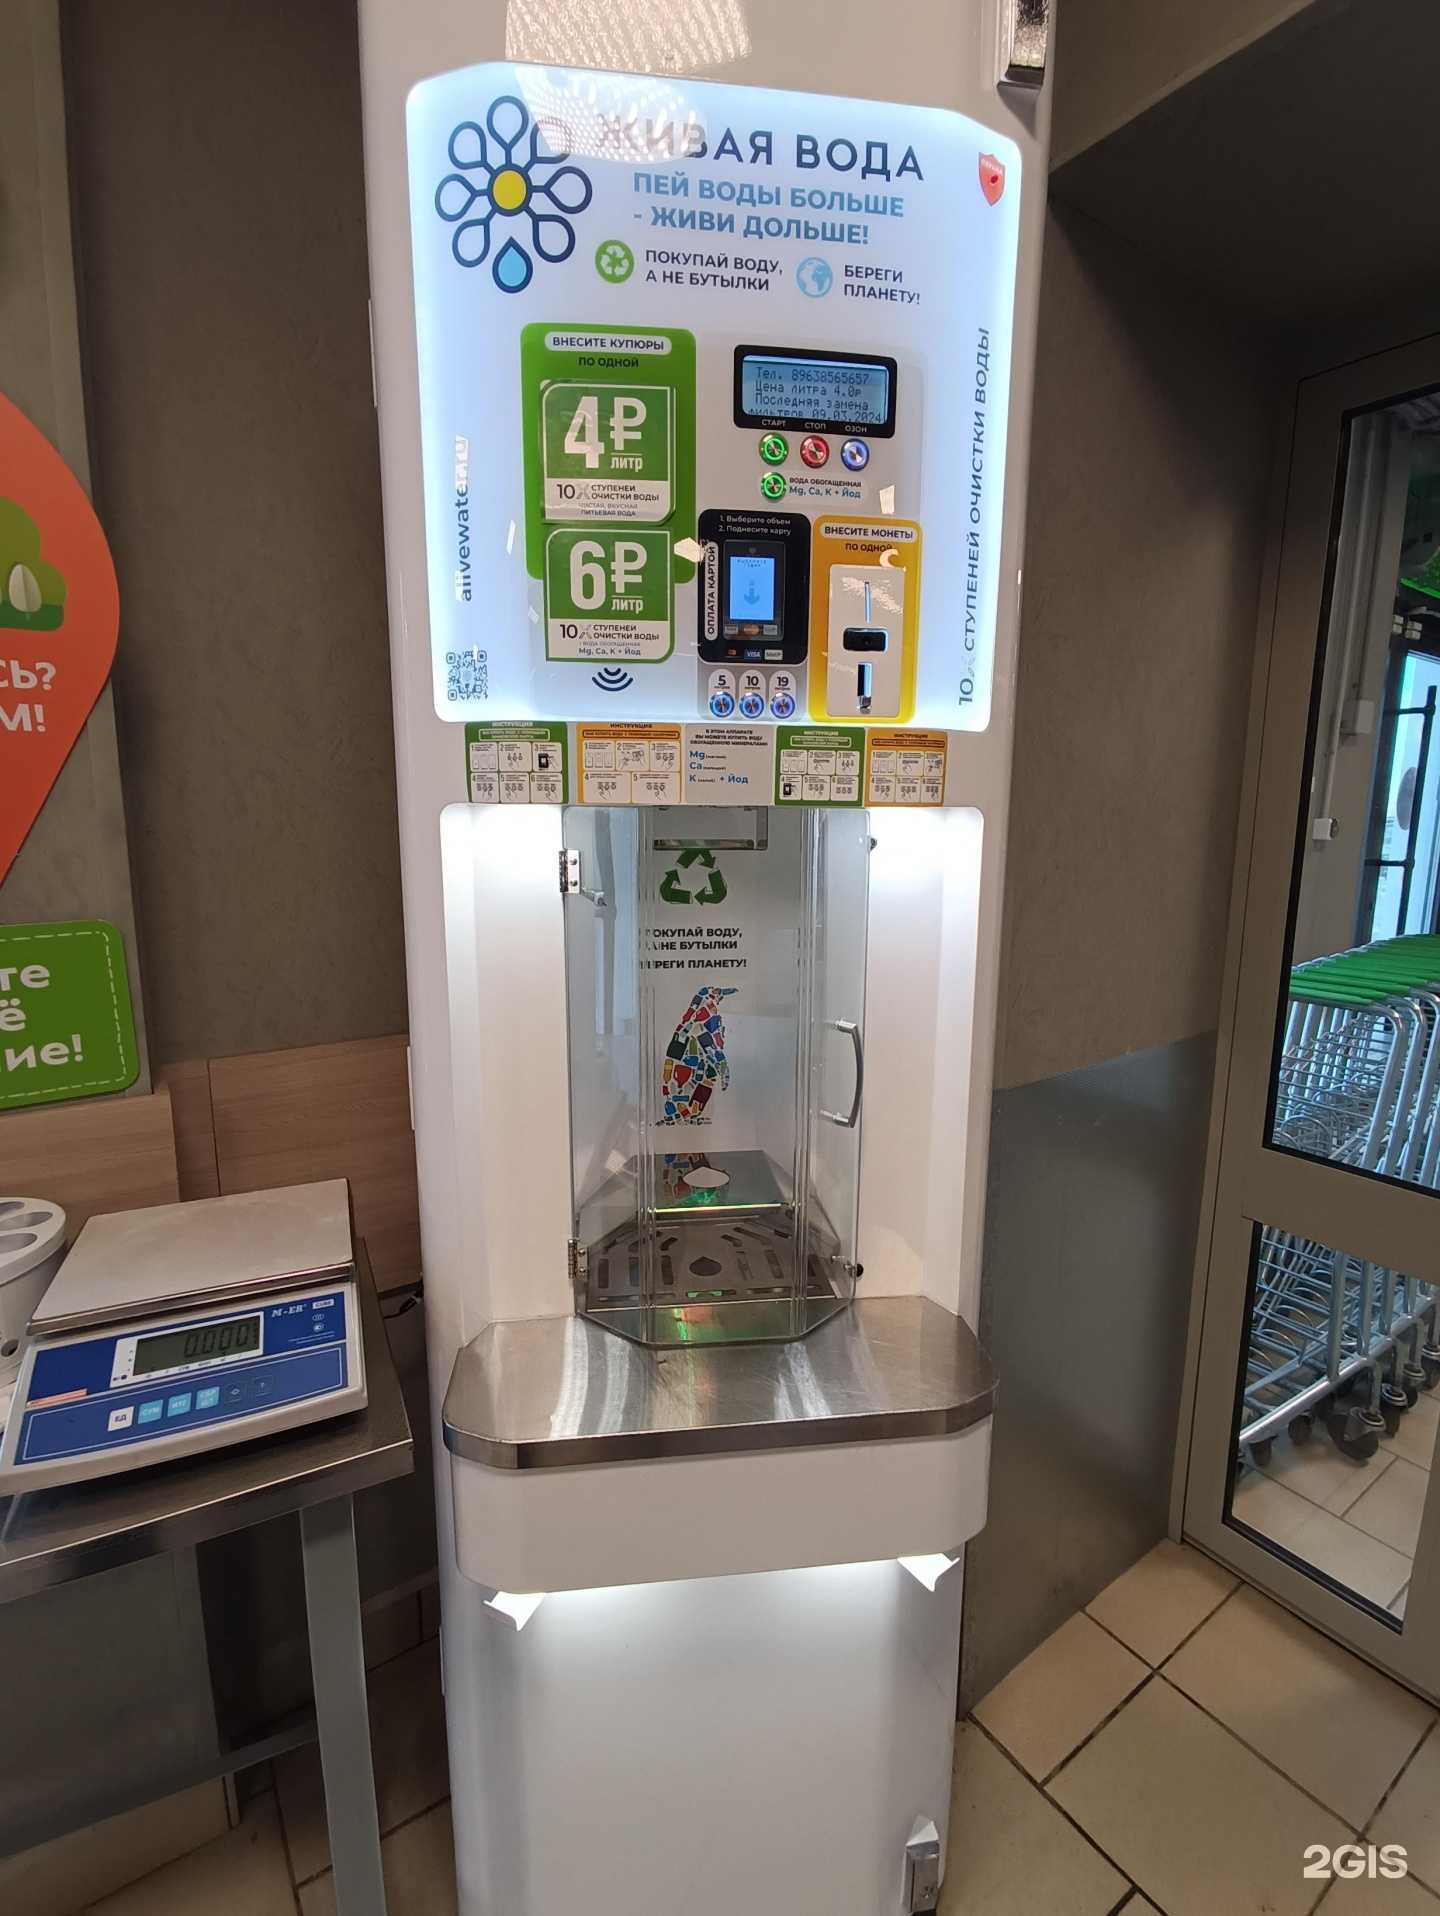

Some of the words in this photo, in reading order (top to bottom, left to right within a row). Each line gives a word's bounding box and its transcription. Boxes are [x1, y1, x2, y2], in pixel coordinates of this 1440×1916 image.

[796, 134, 924, 182] ВОДА
[633, 171, 689, 198] ПЕЙ
[698, 179, 781, 206] ВОДЫ
[790, 187, 904, 218] БОЛЬШЕ
[650, 206, 735, 233] ЖИВИ
[743, 215, 869, 245] ДОЛЬШЕ!
[645, 249, 729, 271] ПОКУПАЙ
[733, 257, 783, 275] ВОДУ,
[844, 264, 903, 283] БЕРЕГИ
[645, 270, 657, 282] А
[662, 270, 684, 284] НЕ
[689, 272, 769, 291] БУТЫЛКИ
[844, 283, 920, 304] ПЛАНЕТУ!
[552, 336, 606, 348] ВНЕСИТЕ
[610, 338, 664, 350] КУПЮРЫ
[578, 356, 596, 366] ПО
[598, 356, 639, 368] ОДНОЙ
[974, 327, 990, 404] ВОДЫ
[756, 366, 782, 380] Тел.
[755, 379, 784, 393] Цена
[791, 383, 827, 396] литра
[755, 393, 820, 409] Последняя
[826, 399, 869, 411] замена
[762, 418, 786, 427] СТАРТ
[804, 421, 827, 430] СТОП
[844, 424, 867, 433] ОЗОН
[610, 456, 643, 473] литр
[970, 410, 986, 524] ОЧИСТКИ
[591, 483, 636, 492] СТУПЕНЕЙ
[789, 477, 809, 485] ВОДА
[810, 478, 862, 488] ОБОГАЩЕННАЯ
[591, 492, 632, 501] ОЧИСТКИ
[633, 493, 660, 502] ВОДЫ
[841, 487, 861, 499] Йод
[726, 515, 765, 524] Выберите
[766, 517, 791, 525] объем
[726, 525, 769, 534] Поднесите
[769, 528, 792, 537] карту
[824, 526, 869, 536] ВНЕСИТЕ
[871, 528, 913, 539] МОНЕТЫ
[845, 543, 859, 551] ПО
[705, 546, 716, 588] КАРТОЙ
[963, 532, 981, 652] СТУПЕНЕЙ
[611, 598, 643, 614] литр
[707, 591, 716, 635] ОПЛАТА
[593, 624, 637, 632] СТУПЕНЕЙ
[593, 632, 632, 640] ОЧИСТКИ
[634, 633, 660, 641] ВОДЫ
[718, 674, 727, 686] 5
[746, 675, 760, 687] 10
[776, 676, 789, 687] 19
[689, 750, 705, 760] Mg
[689, 761, 703, 770] Ca
[727, 772, 749, 785] Йод
[706, 928, 742, 938] ВОДУ,
[661, 941, 677, 950] НЕ
[680, 940, 738, 950] БУТЫЛКИ
[688, 959, 747, 969] ПЛАНЕТУ!
